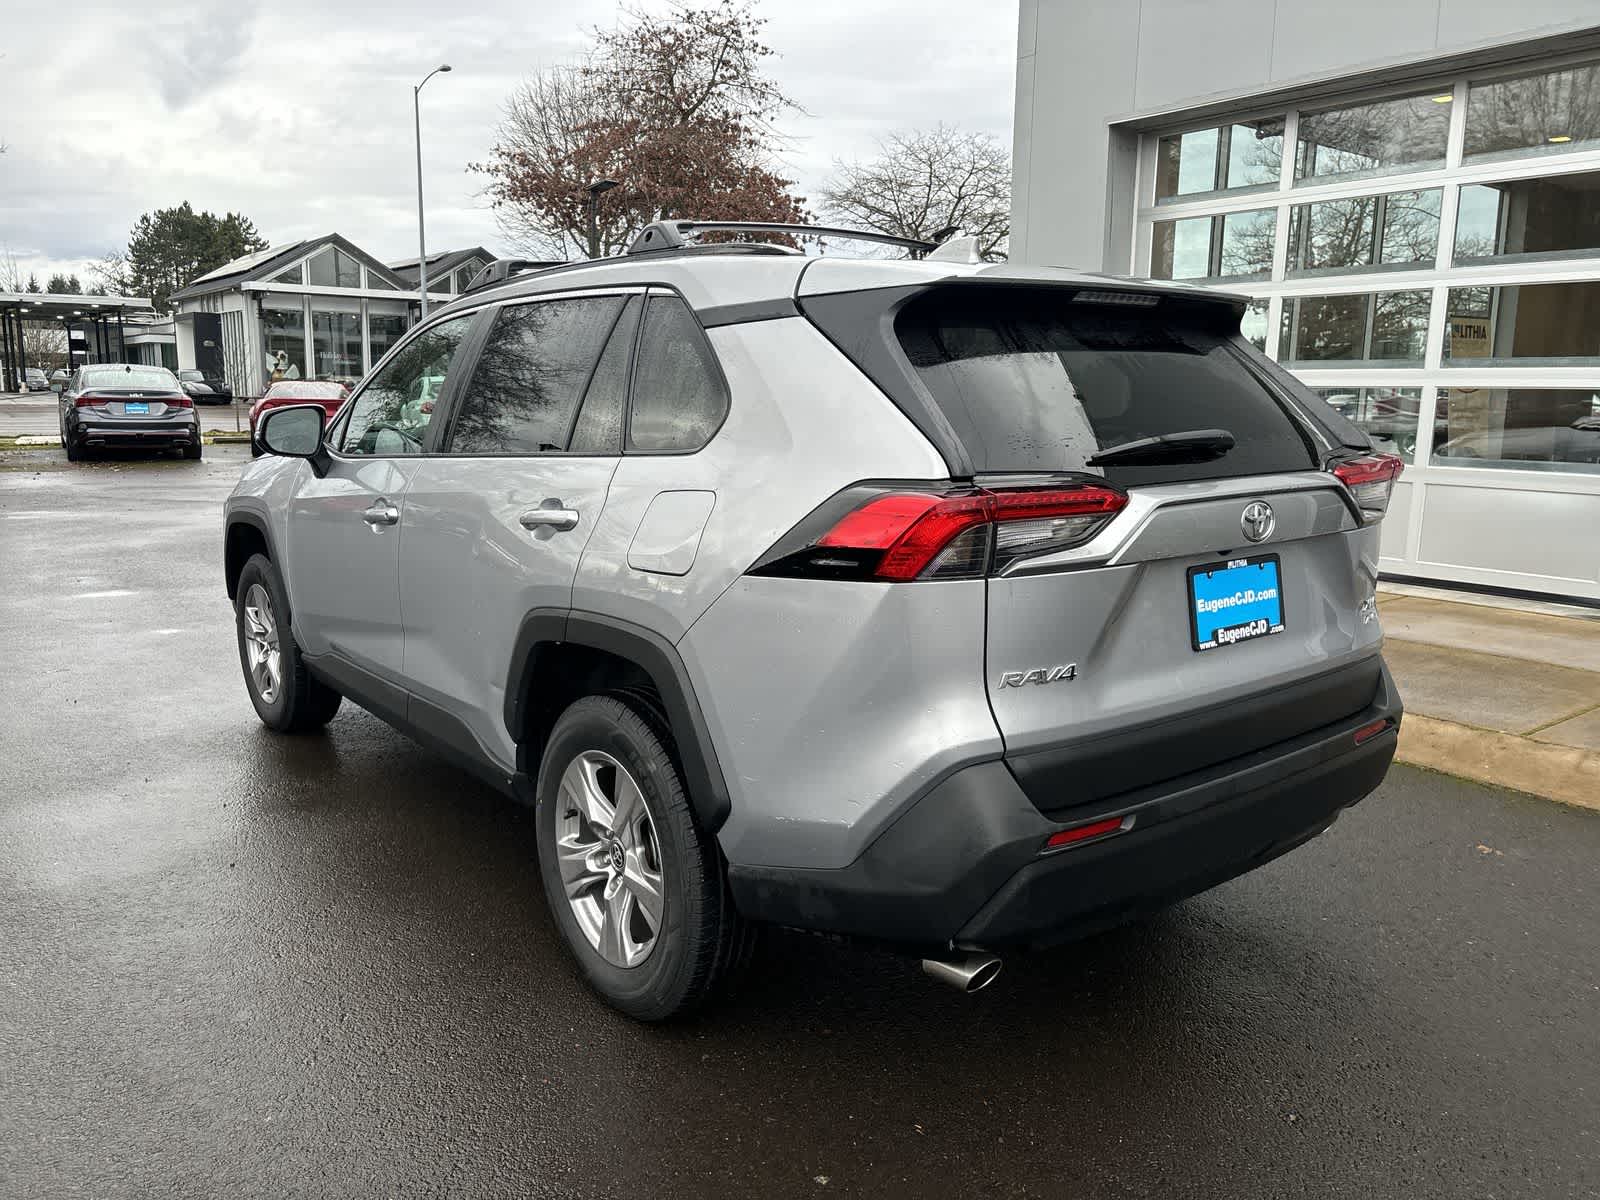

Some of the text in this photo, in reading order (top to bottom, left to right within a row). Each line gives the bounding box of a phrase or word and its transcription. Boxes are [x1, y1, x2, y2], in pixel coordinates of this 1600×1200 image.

[1459, 325, 1487, 339] LITHIA
[1197, 588, 1277, 613] EugeneCJD.com
[1217, 619, 1267, 643] EugeneCJD
[998, 663, 1078, 689] RAV4
